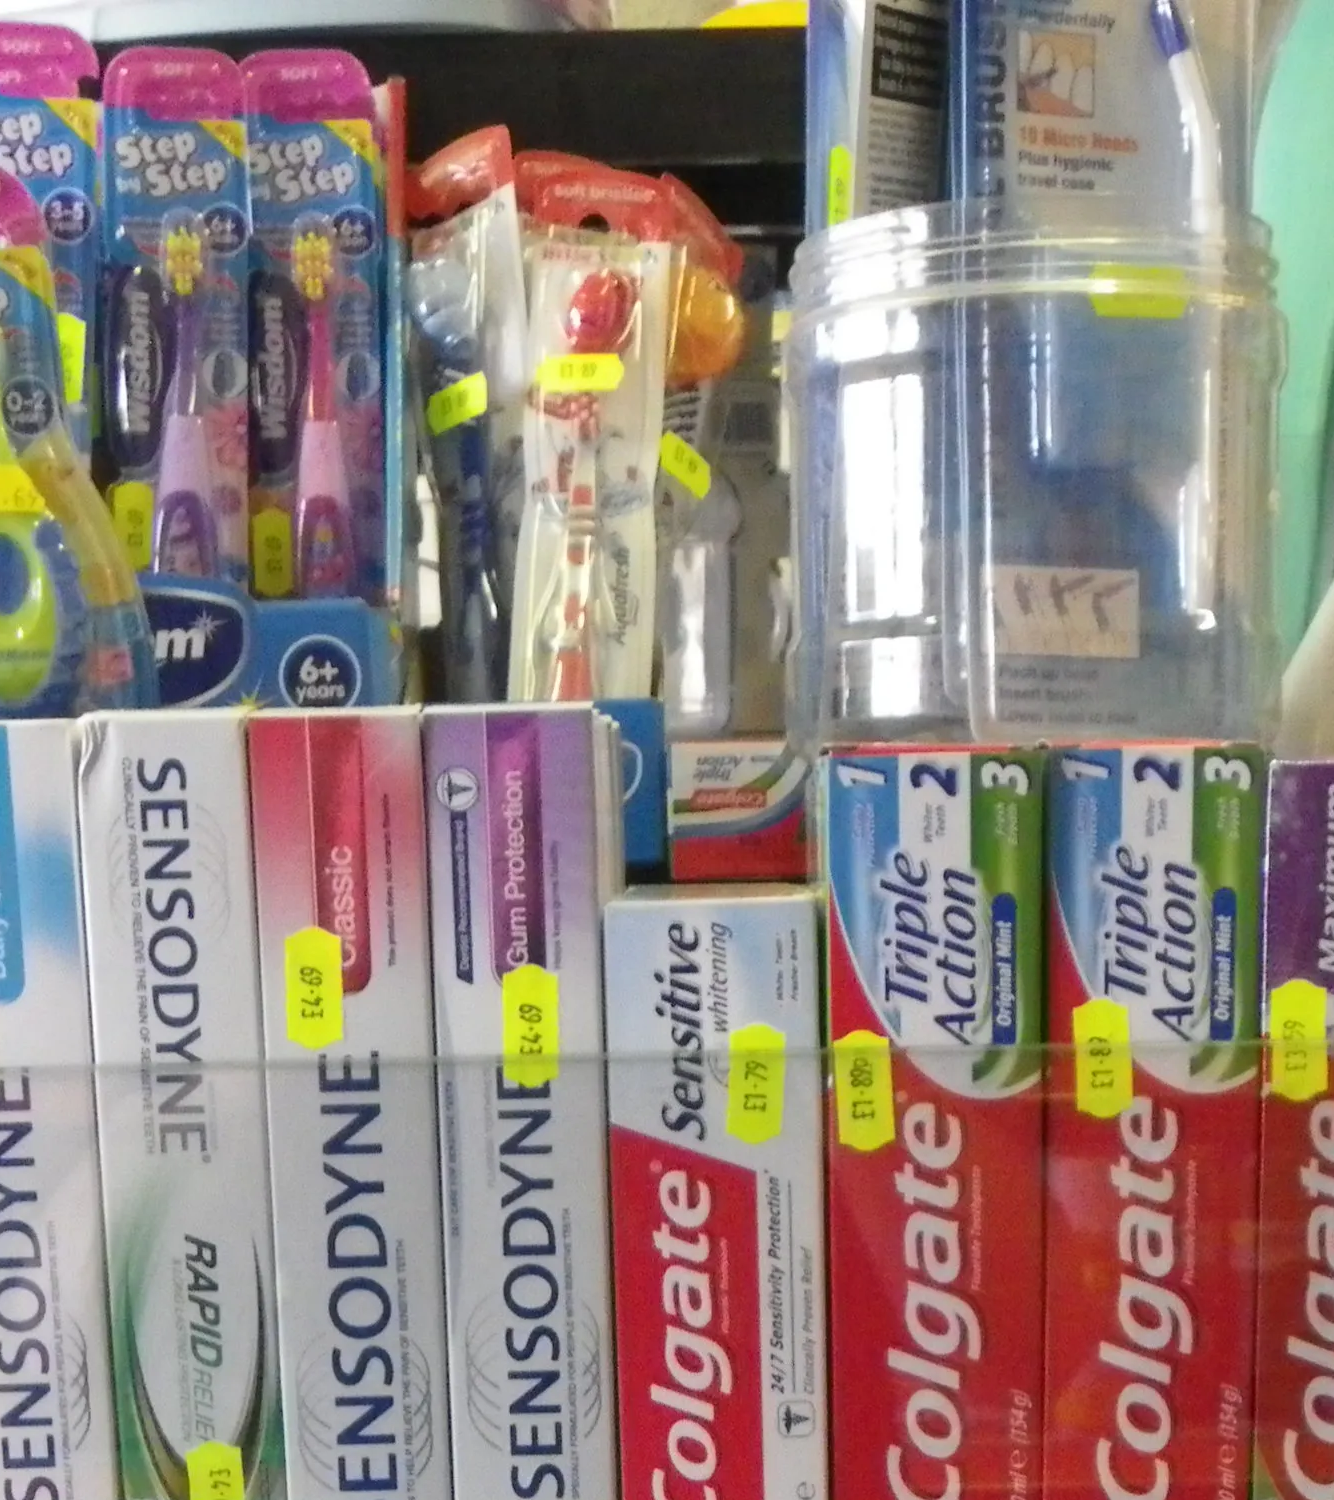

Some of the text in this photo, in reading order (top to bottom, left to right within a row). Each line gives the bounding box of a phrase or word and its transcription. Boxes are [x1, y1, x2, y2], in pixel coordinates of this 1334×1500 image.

[1017, 172, 1057, 186] travel
[613, 533, 632, 647] Aquafresh
[296, 681, 346, 701] years
[299, 657, 340, 682] 6+
[835, 760, 1030, 796] 1 2 3
[326, 845, 357, 968] Classic
[502, 769, 531, 968] Gum Protection
[880, 851, 931, 1002] Triple
[934, 867, 978, 1046] Action
[996, 921, 1014, 1026] Original Mint
[1213, 915, 1231, 1021] Original Mint
[653, 922, 733, 1141] Sensitive whitening
[185, 1233, 224, 1369] RAPID
[766, 1178, 786, 1395] 24/7 Sensitivity Protection
